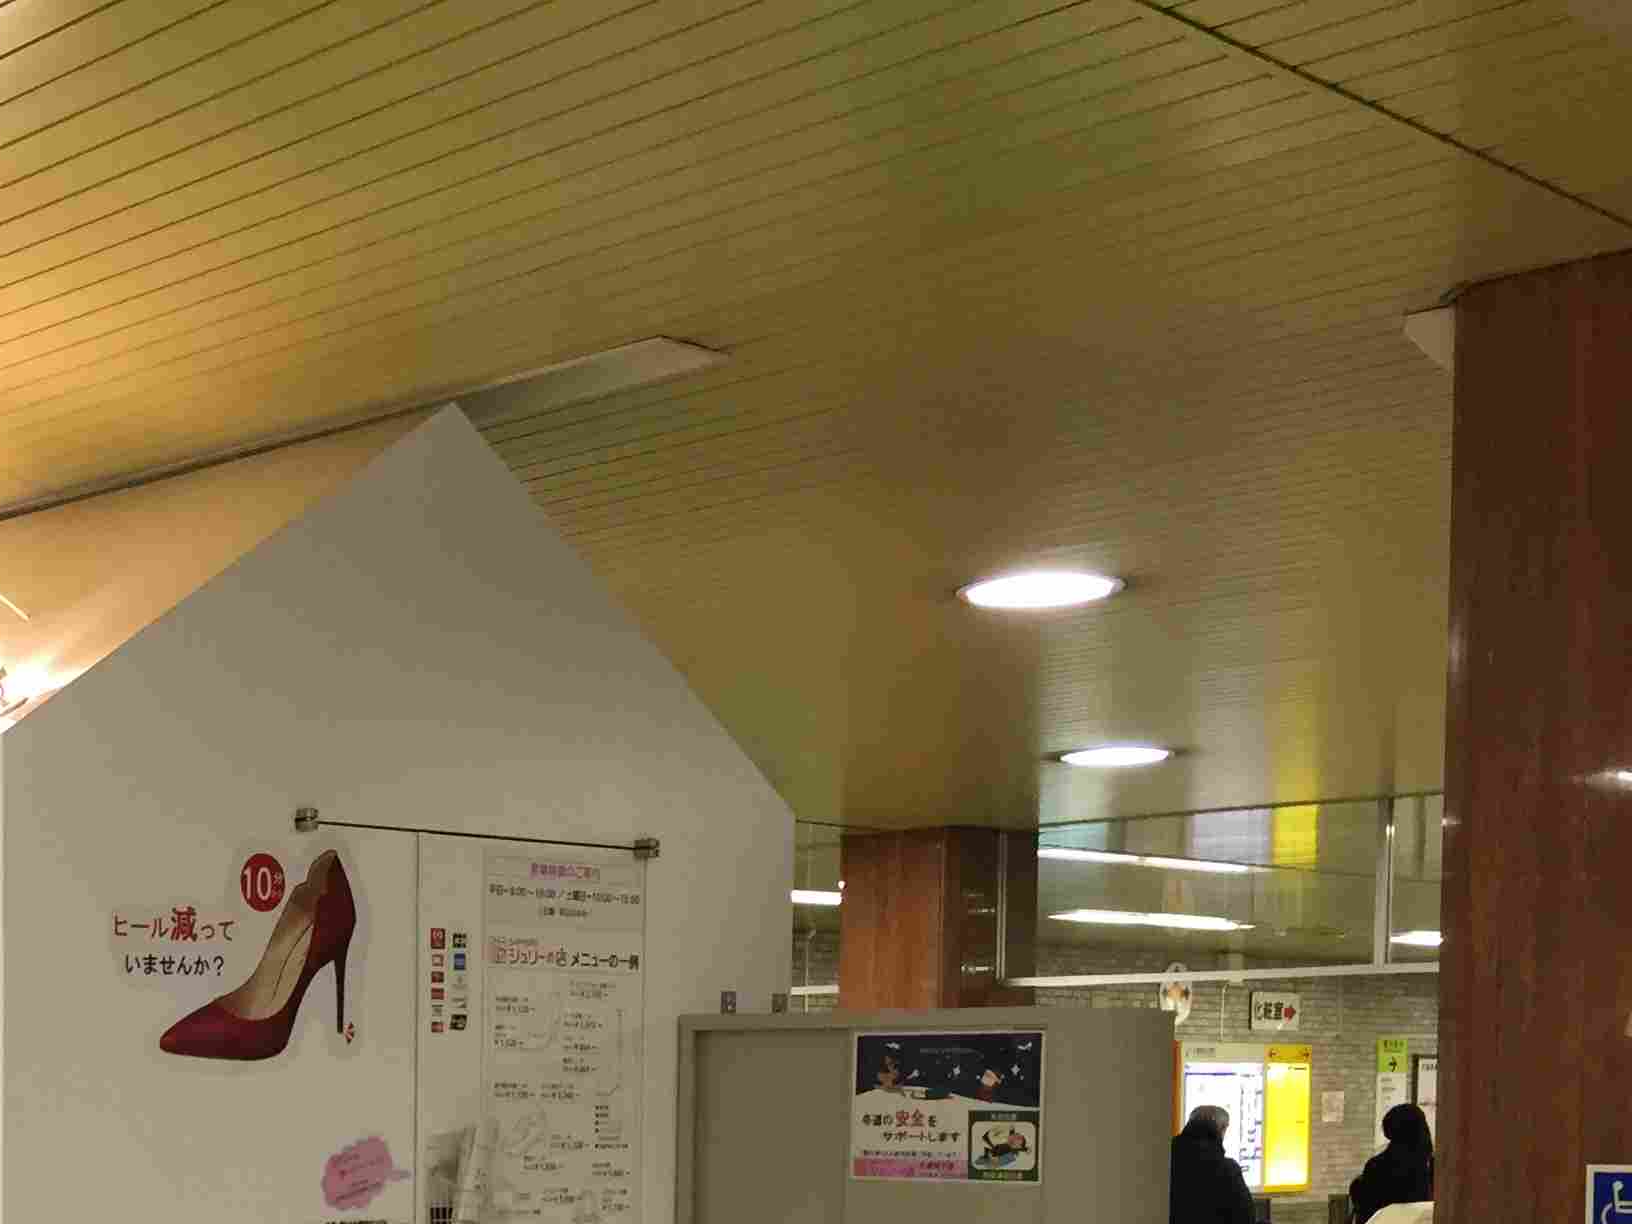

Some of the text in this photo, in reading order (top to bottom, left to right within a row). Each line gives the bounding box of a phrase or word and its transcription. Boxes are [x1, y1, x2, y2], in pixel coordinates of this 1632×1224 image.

[112, 905, 236, 942] ヒール減って
